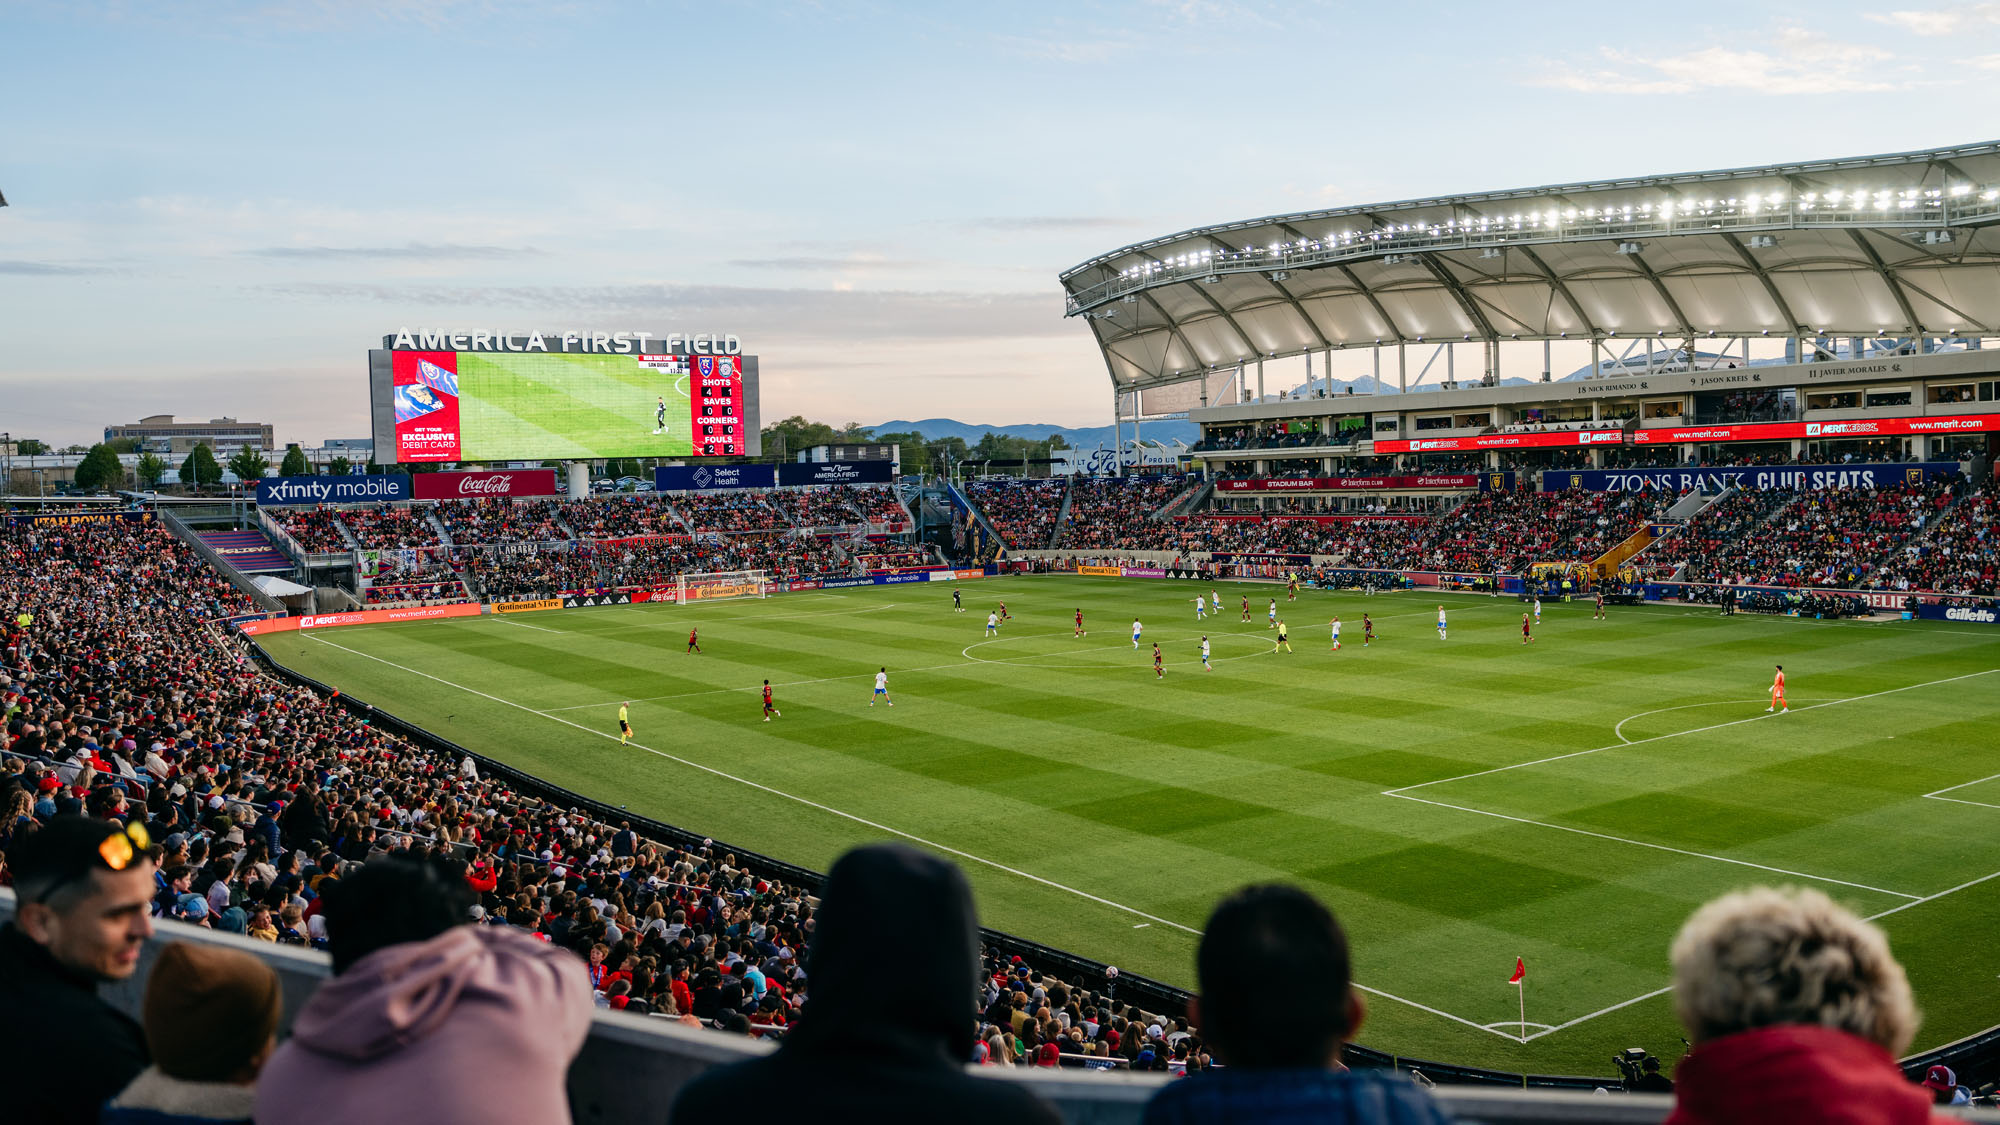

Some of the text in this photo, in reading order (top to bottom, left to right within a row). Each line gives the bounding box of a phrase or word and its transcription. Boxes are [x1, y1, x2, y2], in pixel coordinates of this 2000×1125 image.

[393, 326, 742, 354] AMERICA FIRST FIELD
[1809, 365, 1887, 378] 11 JAVIER MORALES
[1690, 375, 1748, 386] 9 JASON KREIS
[706, 388, 732, 396] 4 1
[1578, 386, 1587, 394] 18
[1605, 383, 1637, 391] RIMANDO
[707, 407, 732, 415] 0 0
[708, 426, 733, 434] 0 0
[1909, 419, 1983, 430] www.merit.com
[402, 433, 455, 441] EXCLUSIVE
[1673, 429, 1730, 439] www.merit.com
[402, 441, 428, 449] DEBIT
[708, 445, 734, 453] 2 2
[714, 468, 740, 477] Select
[458, 475, 513, 494] Coca-Cola
[714, 477, 739, 486] Health
[1605, 474, 1673, 492] ZIONS
[1679, 472, 1745, 492] BANK
[1812, 470, 1874, 490] SEATS
[268, 478, 399, 501] xfinity mobile
[34, 516, 68, 527] UTAH
[824, 580, 858, 588] Intermountain
[858, 578, 875, 586] Health
[701, 586, 736, 598] Continental
[497, 601, 537, 612] Continental
[389, 608, 445, 619] www.merit.com
[1945, 607, 1996, 622] Gillette
